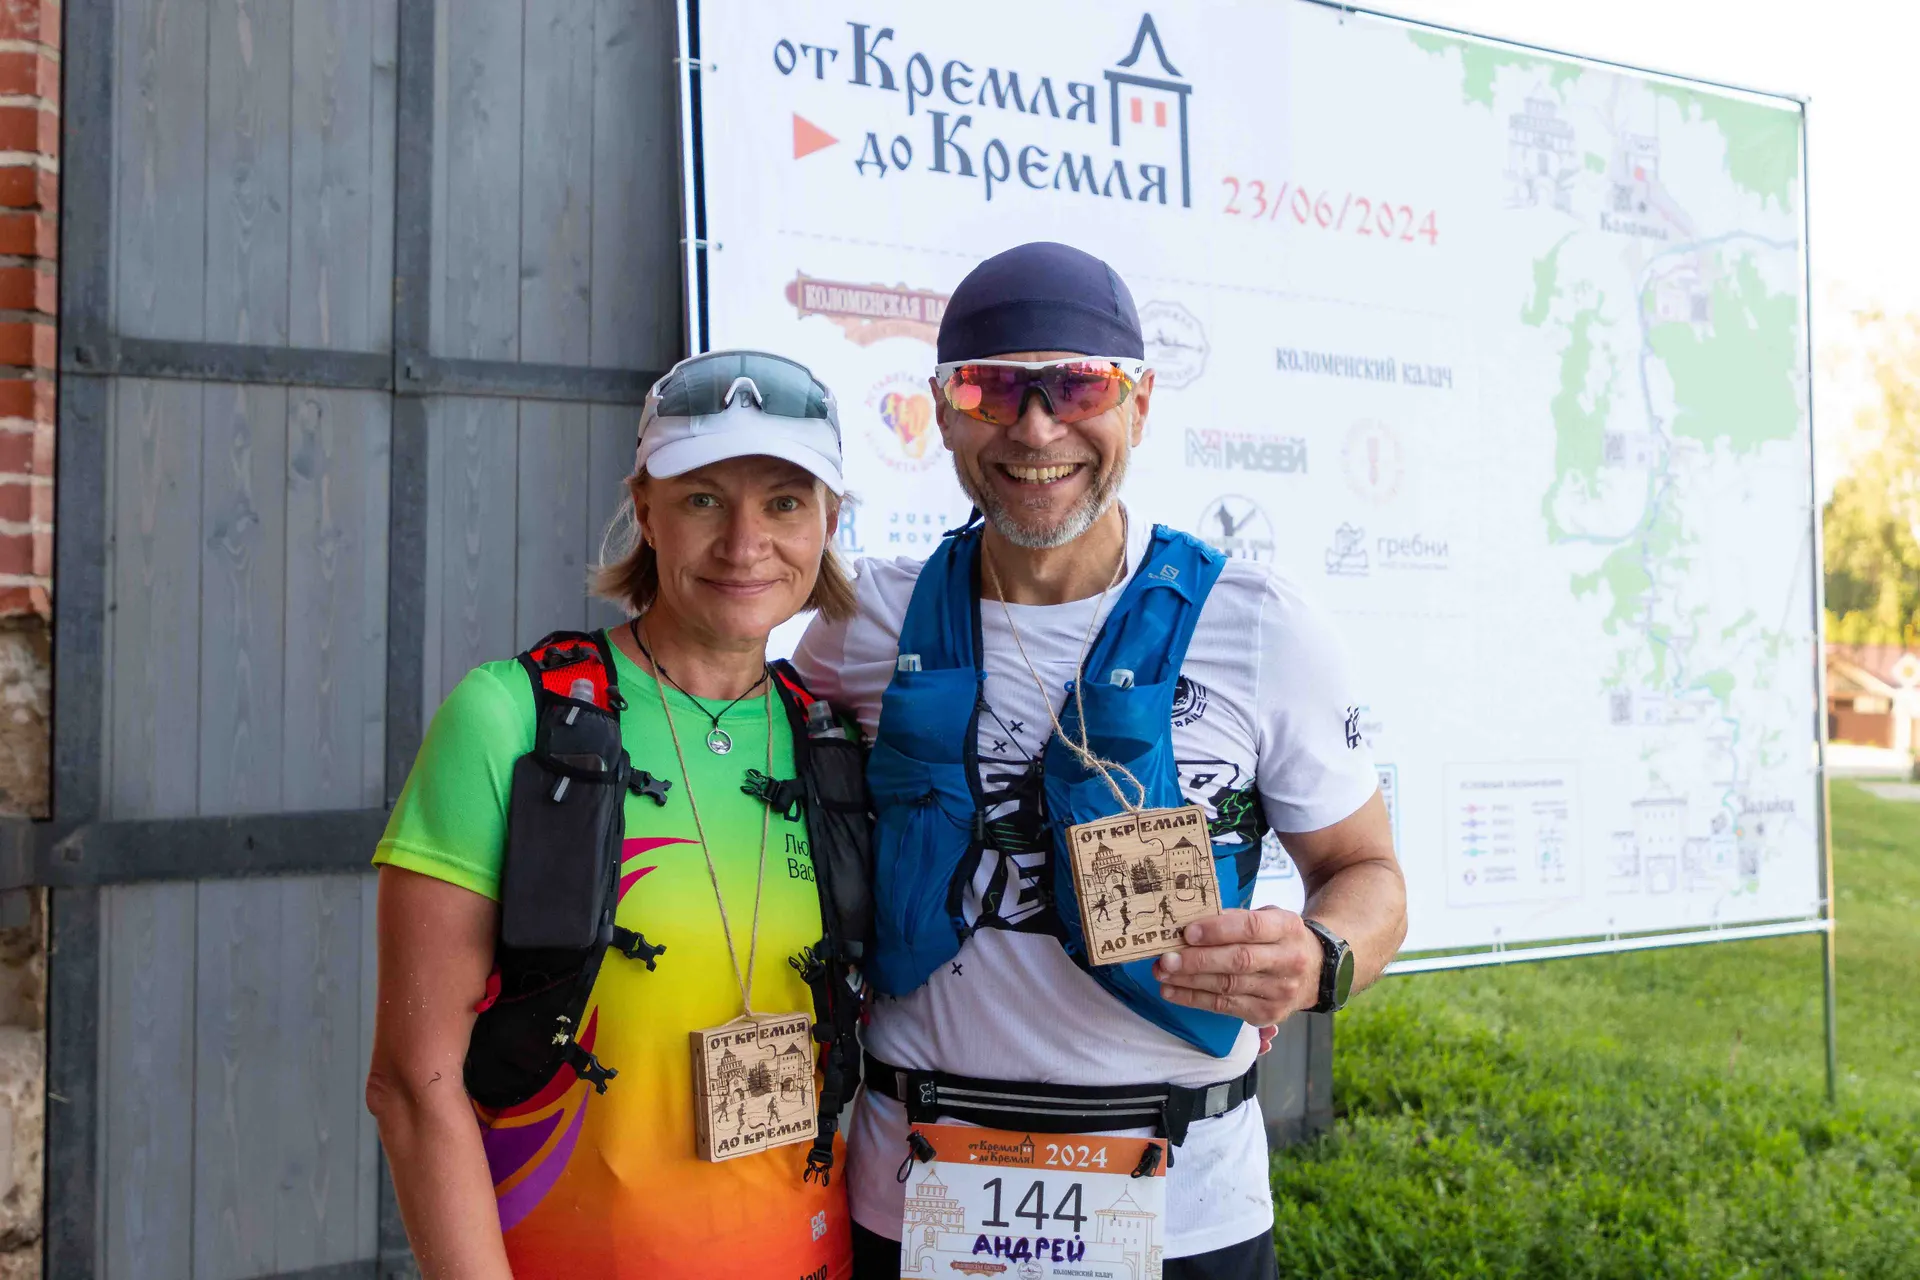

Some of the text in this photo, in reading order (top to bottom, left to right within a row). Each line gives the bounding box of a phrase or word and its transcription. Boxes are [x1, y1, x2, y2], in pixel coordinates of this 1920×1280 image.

[773, 21, 1097, 124] от Кремля
[855, 109, 1167, 203] до Кремля
[1222, 176, 1439, 246] 23/06/2024
[804, 284, 921, 320] КОЛОМЕНСКАЯ
[890, 532, 932, 544] MOV
[1377, 534, 1449, 559] гребни
[1171, 713, 1203, 728] RAIL
[1081, 813, 1198, 844] ОТ КРЕМЛЯ
[785, 833, 810, 857] Лю
[1101, 926, 1186, 955] ДО КРЕМ
[710, 1021, 806, 1050] ОТ КРЕМЛЯ
[717, 1118, 813, 1153] ДО КРЕМЛЯ
[1045, 1143, 1108, 1168] 2024
[981, 1176, 1088, 1233] 144
[971, 1233, 1086, 1264] АНДРЕЙ
